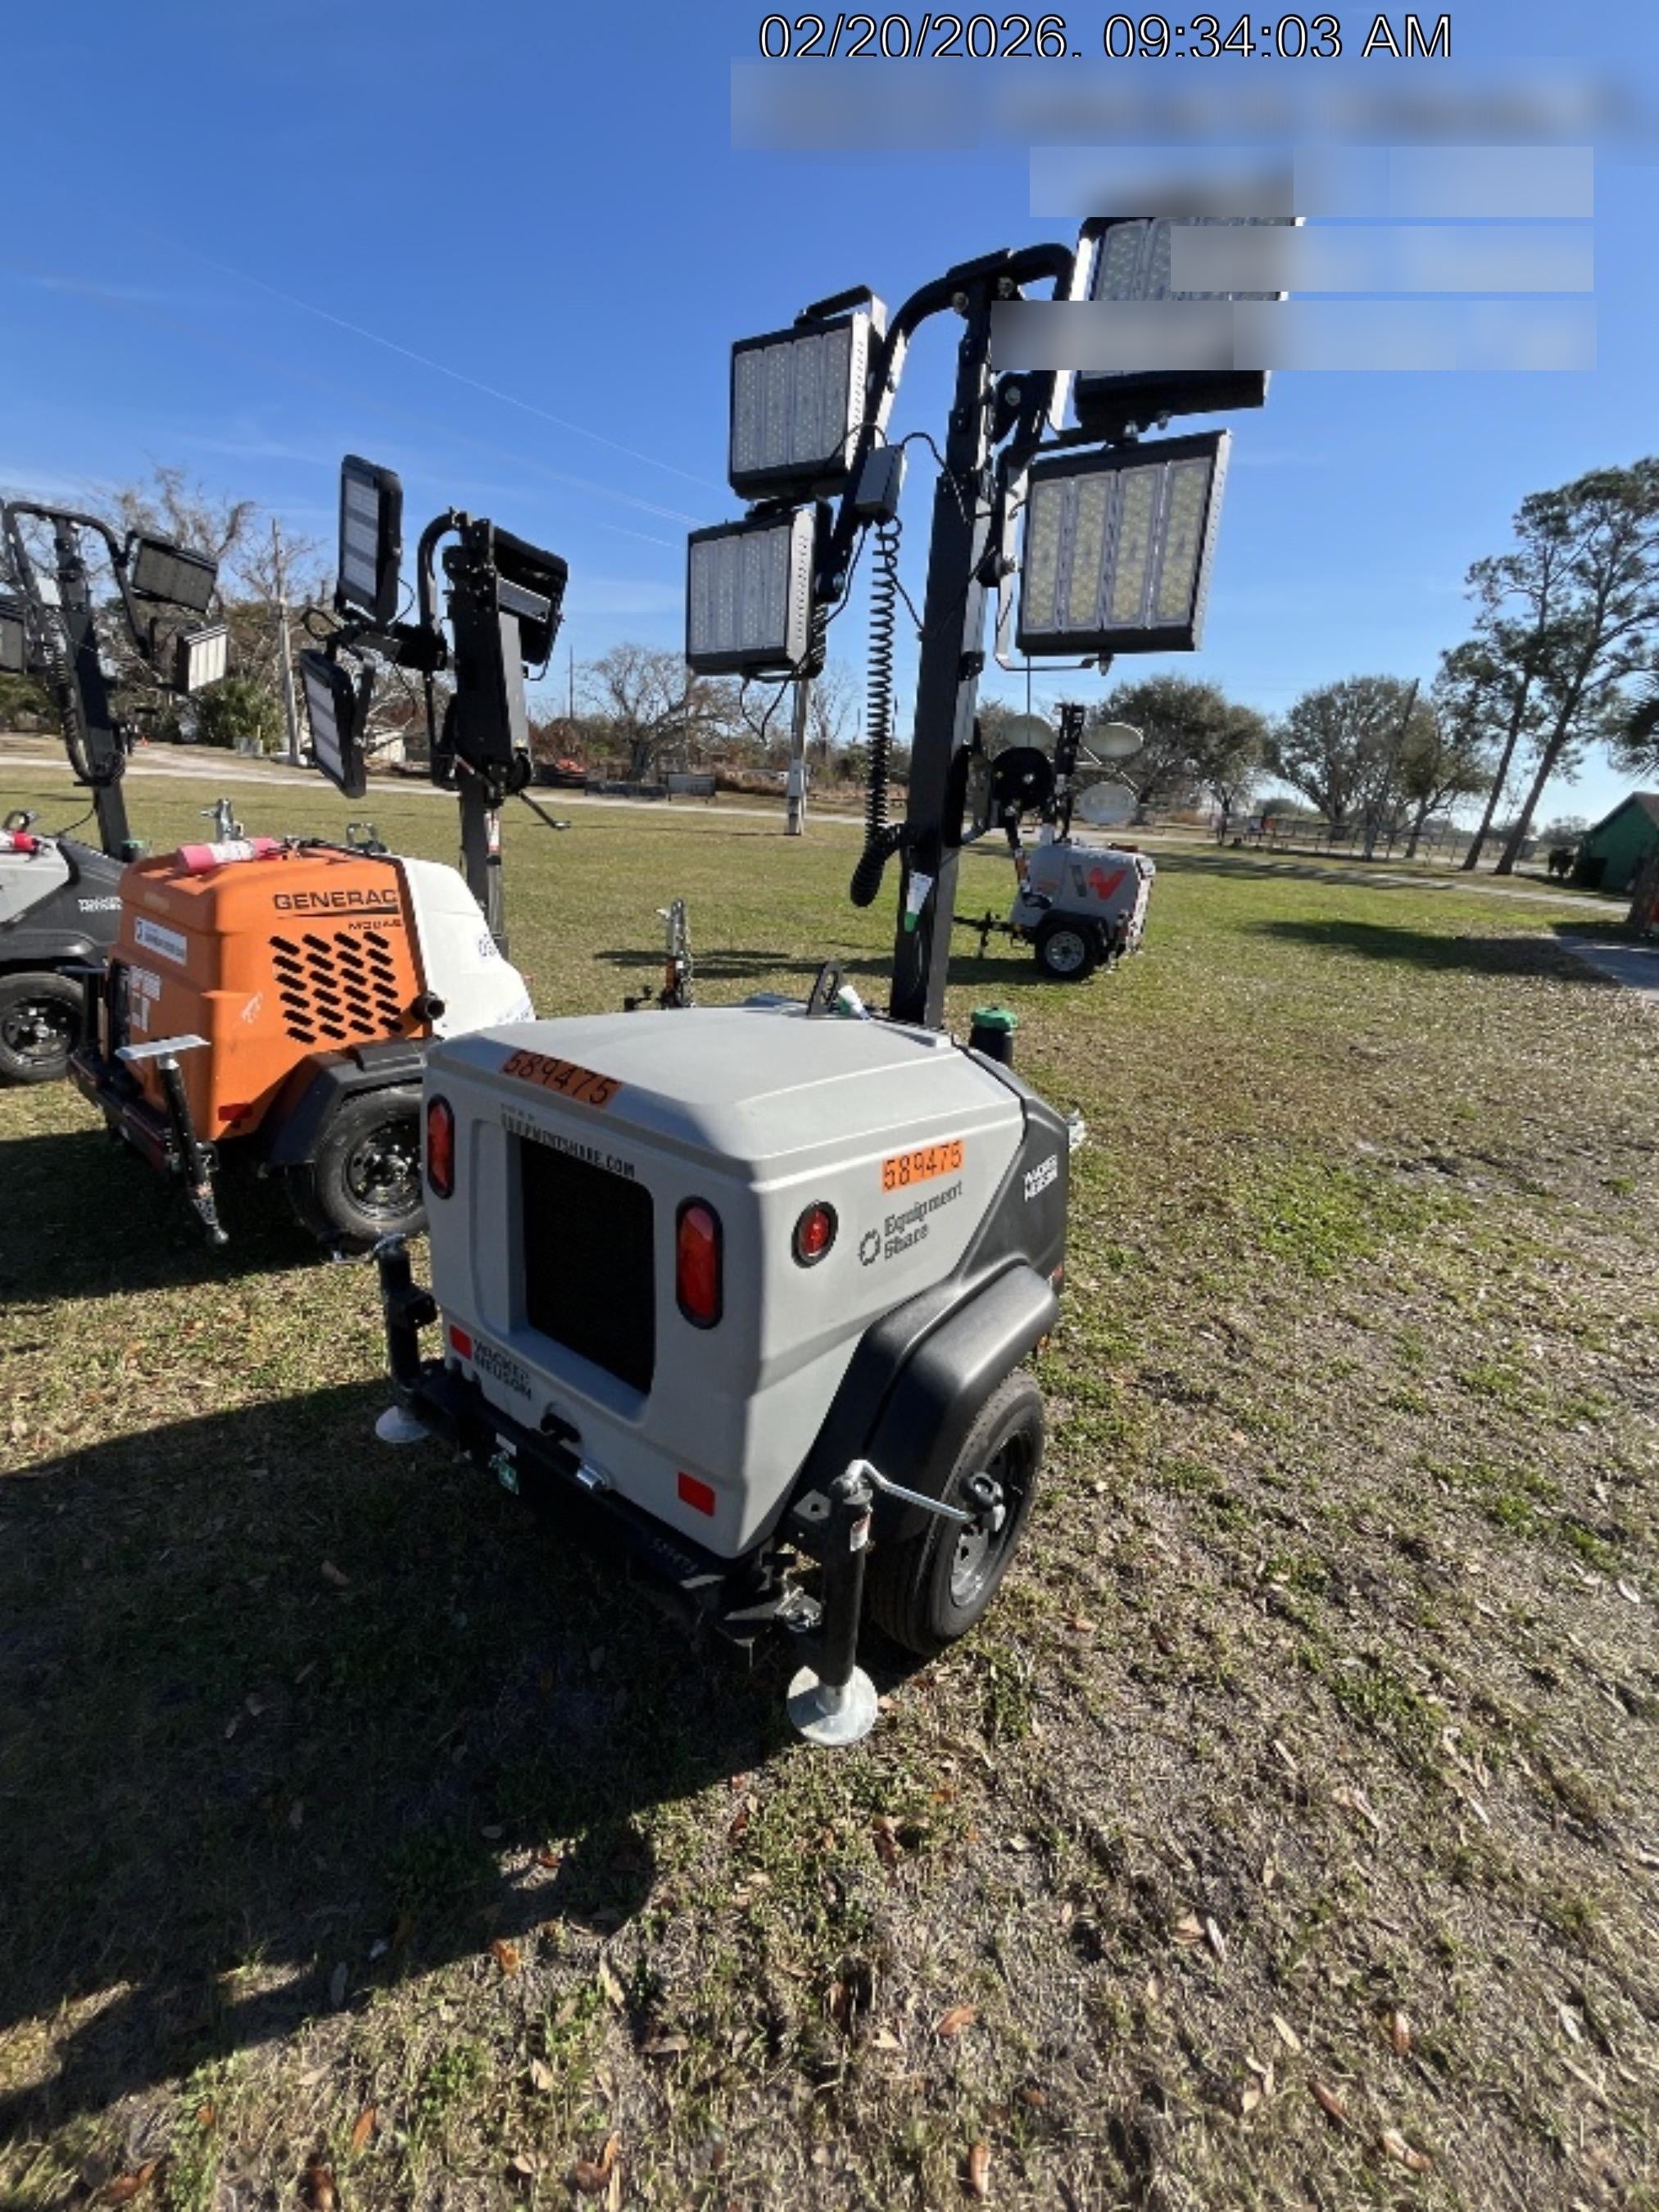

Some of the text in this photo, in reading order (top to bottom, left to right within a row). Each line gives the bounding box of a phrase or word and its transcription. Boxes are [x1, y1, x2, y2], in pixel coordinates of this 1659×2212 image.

[274, 889, 397, 910] GENERAC
[502, 1049, 621, 1104] 589475
[884, 1140, 963, 1190] 589475
[884, 1179, 963, 1237] Equipment
[884, 1224, 929, 1261] Share
